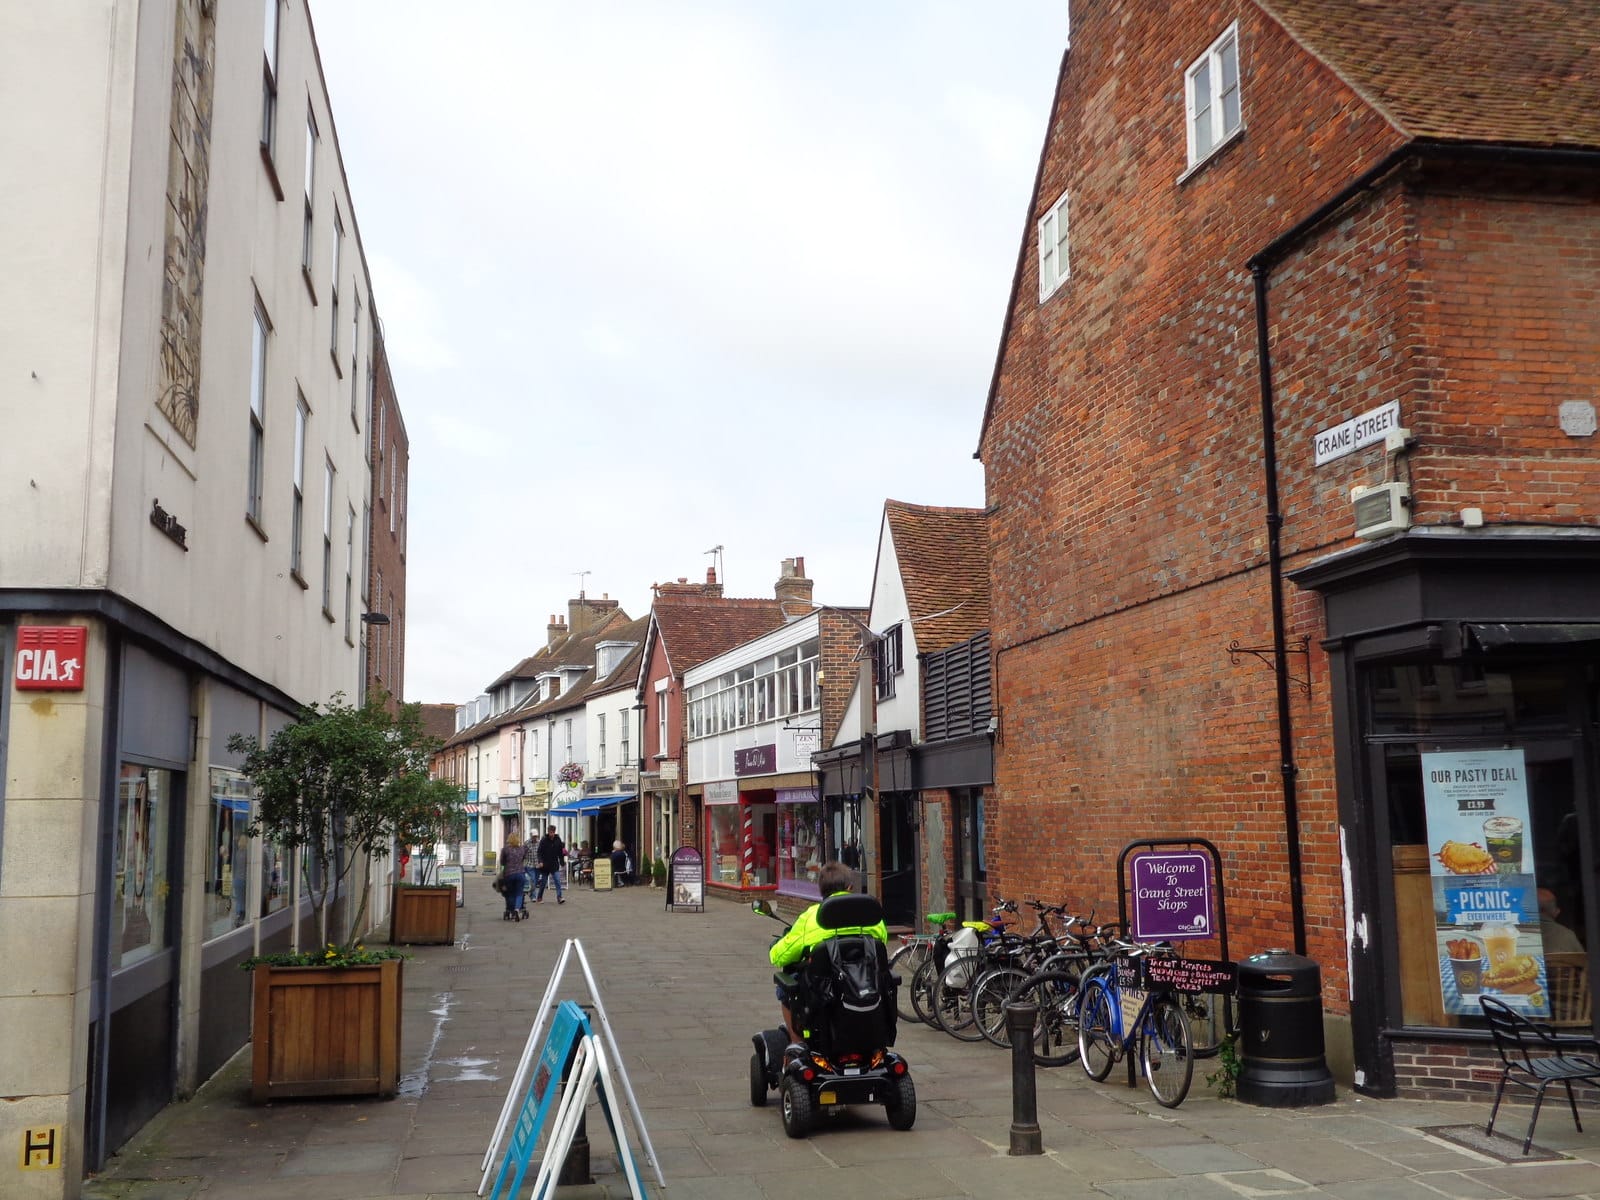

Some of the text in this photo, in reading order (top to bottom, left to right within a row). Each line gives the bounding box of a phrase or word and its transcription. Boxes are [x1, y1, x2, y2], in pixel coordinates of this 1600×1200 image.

[1317, 409, 1394, 456] CRANE STREET
[16, 649, 58, 681] CIA
[1431, 768, 1518, 783] OUR PASTY DEAL
[1146, 862, 1196, 874] Welcome
[1166, 874, 1178, 886] To
[1139, 886, 1204, 899] Crane Street
[1460, 890, 1511, 910] PICNIC
[1157, 898, 1188, 914] Shops
[1467, 911, 1507, 921] EVERYWHERE
[1148, 957, 1212, 972] JACKET POTATOES
[1175, 982, 1202, 992] CAKES
[24, 1128, 55, 1166] H
